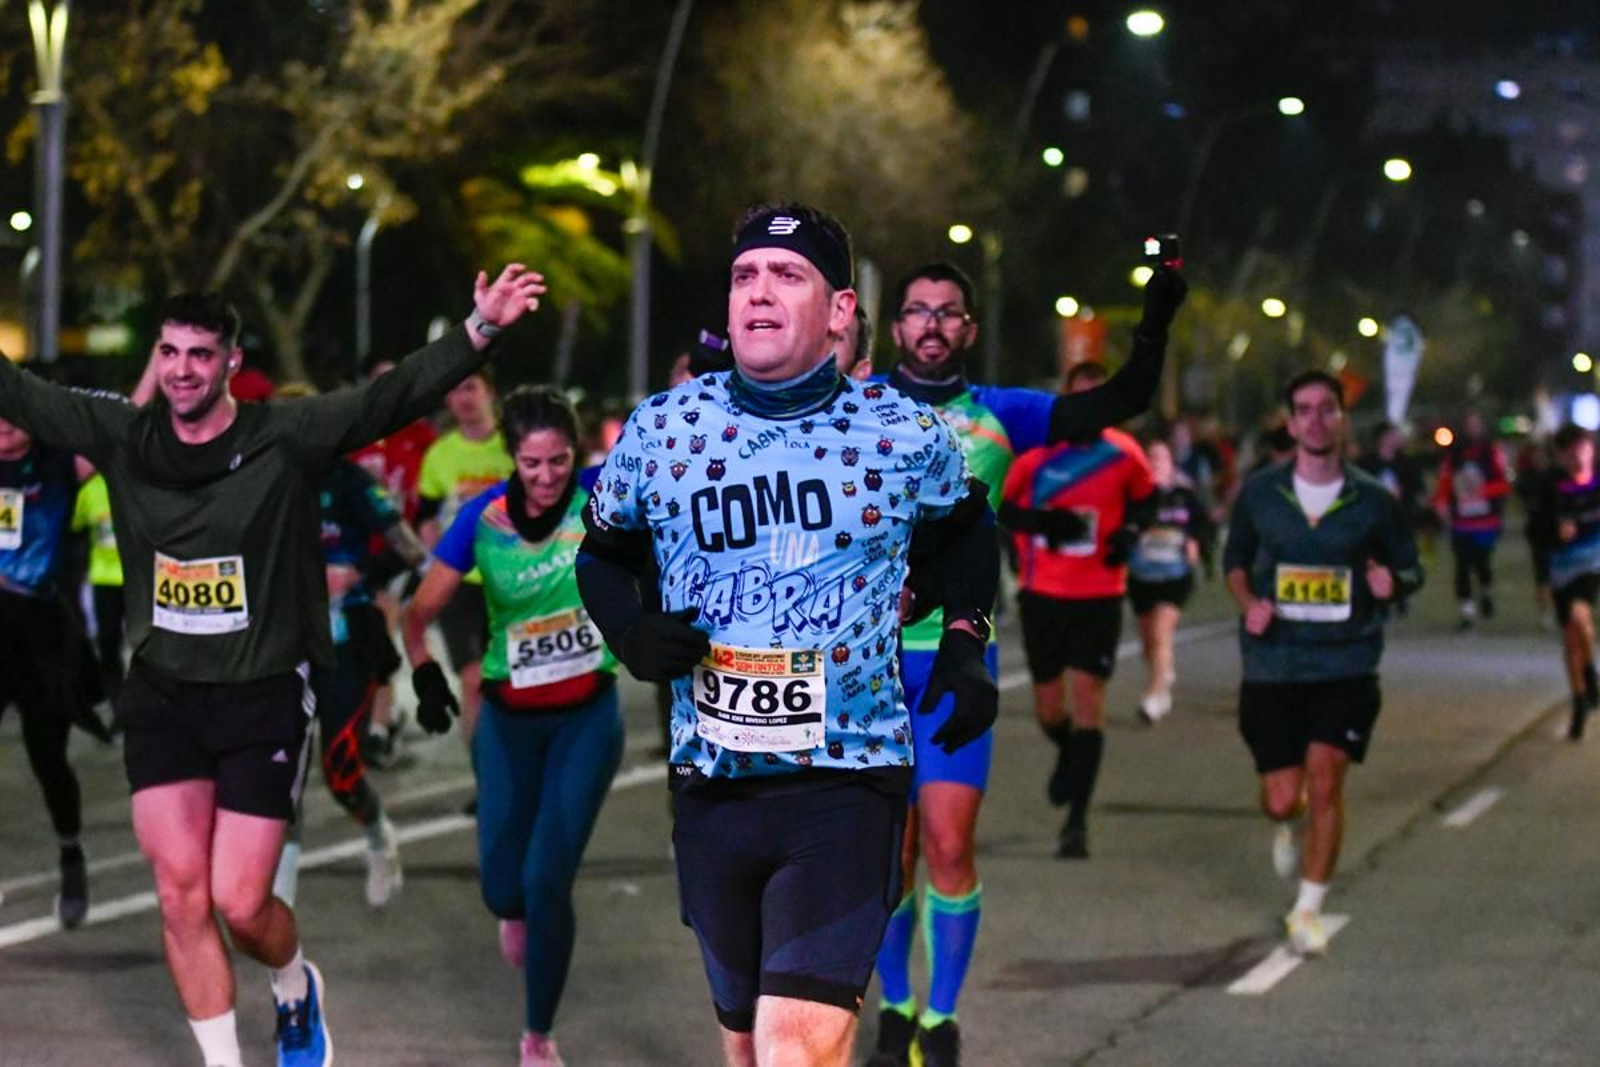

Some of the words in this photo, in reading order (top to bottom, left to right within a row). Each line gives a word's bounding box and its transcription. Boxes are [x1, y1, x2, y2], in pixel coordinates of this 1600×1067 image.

[738, 425, 788, 460] CABRA
[690, 470, 832, 553] COMO
[769, 527, 820, 570] UNA
[158, 578, 235, 606] 4080
[682, 552, 845, 634] CABRA
[518, 624, 594, 668] 5506
[703, 669, 812, 714] 9786
